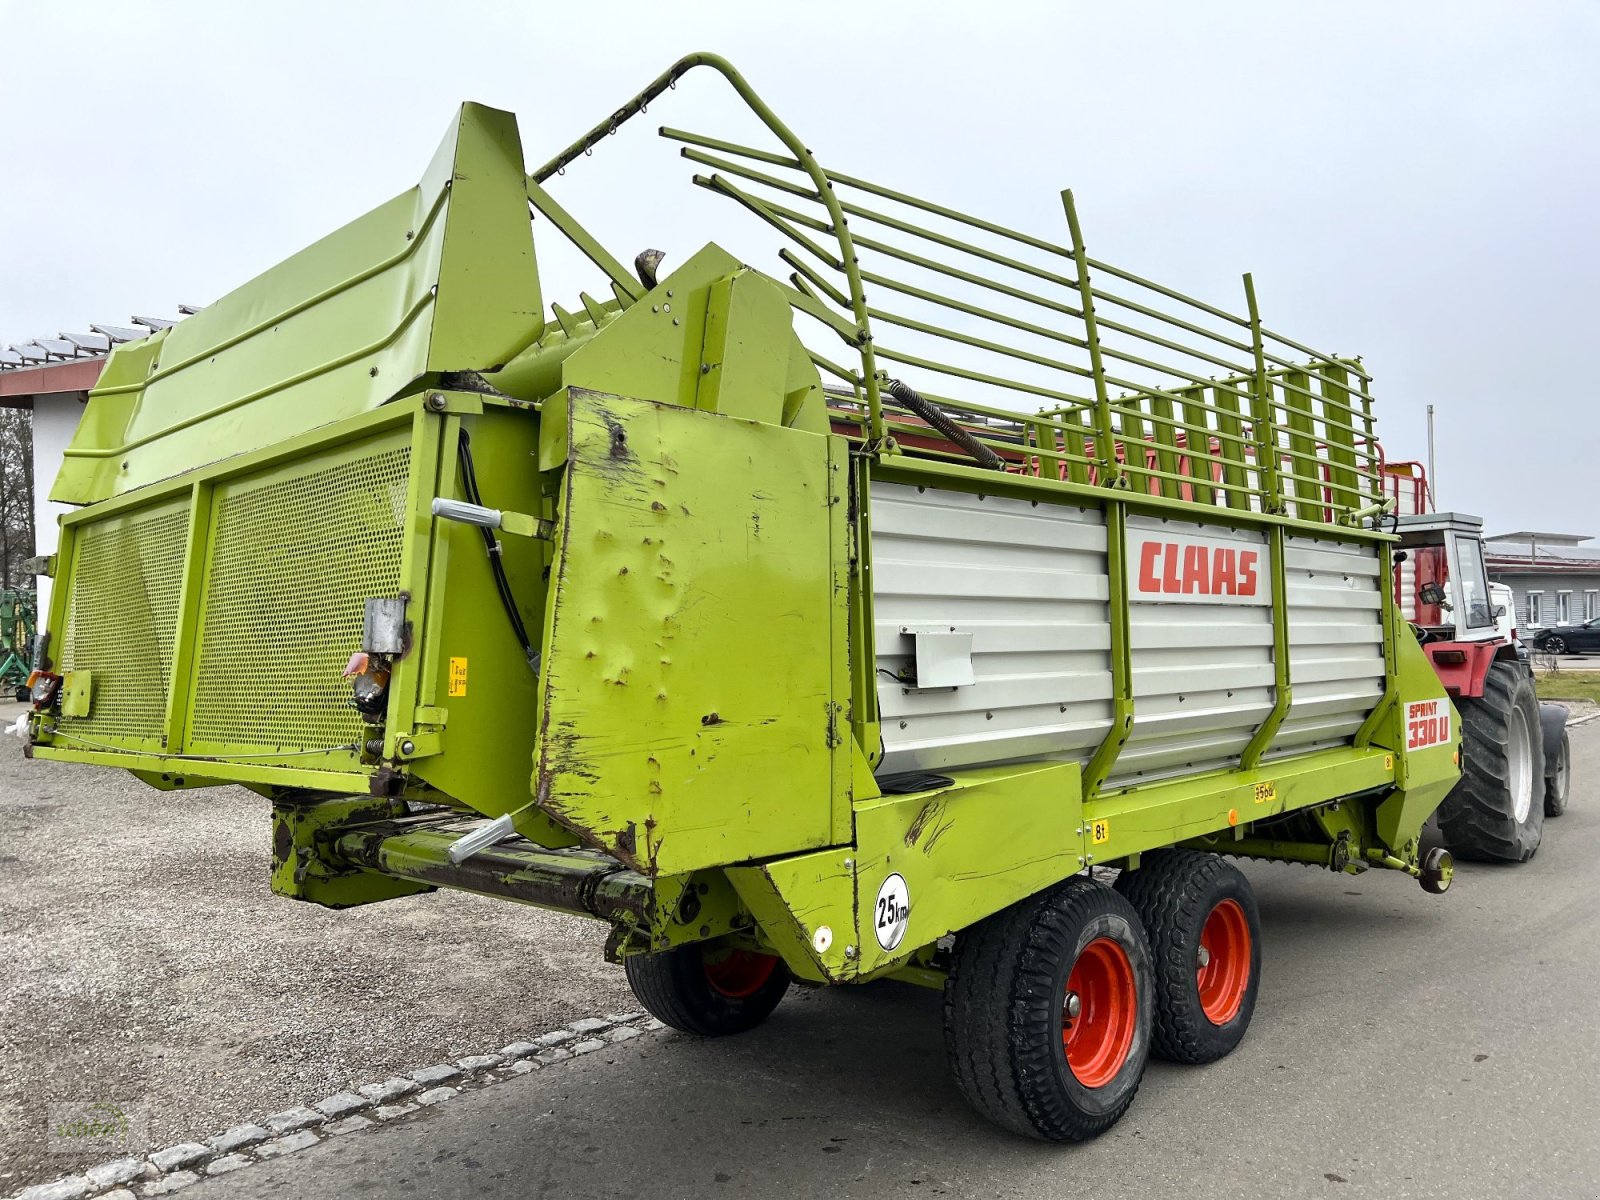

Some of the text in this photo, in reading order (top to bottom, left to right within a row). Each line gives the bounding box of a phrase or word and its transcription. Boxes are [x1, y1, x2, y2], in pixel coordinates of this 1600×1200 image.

[1138, 541, 1258, 596] CLAAS
[1409, 701, 1437, 719] SPRINT
[1408, 716, 1448, 749] 330 U
[1095, 823, 1105, 840] 8t
